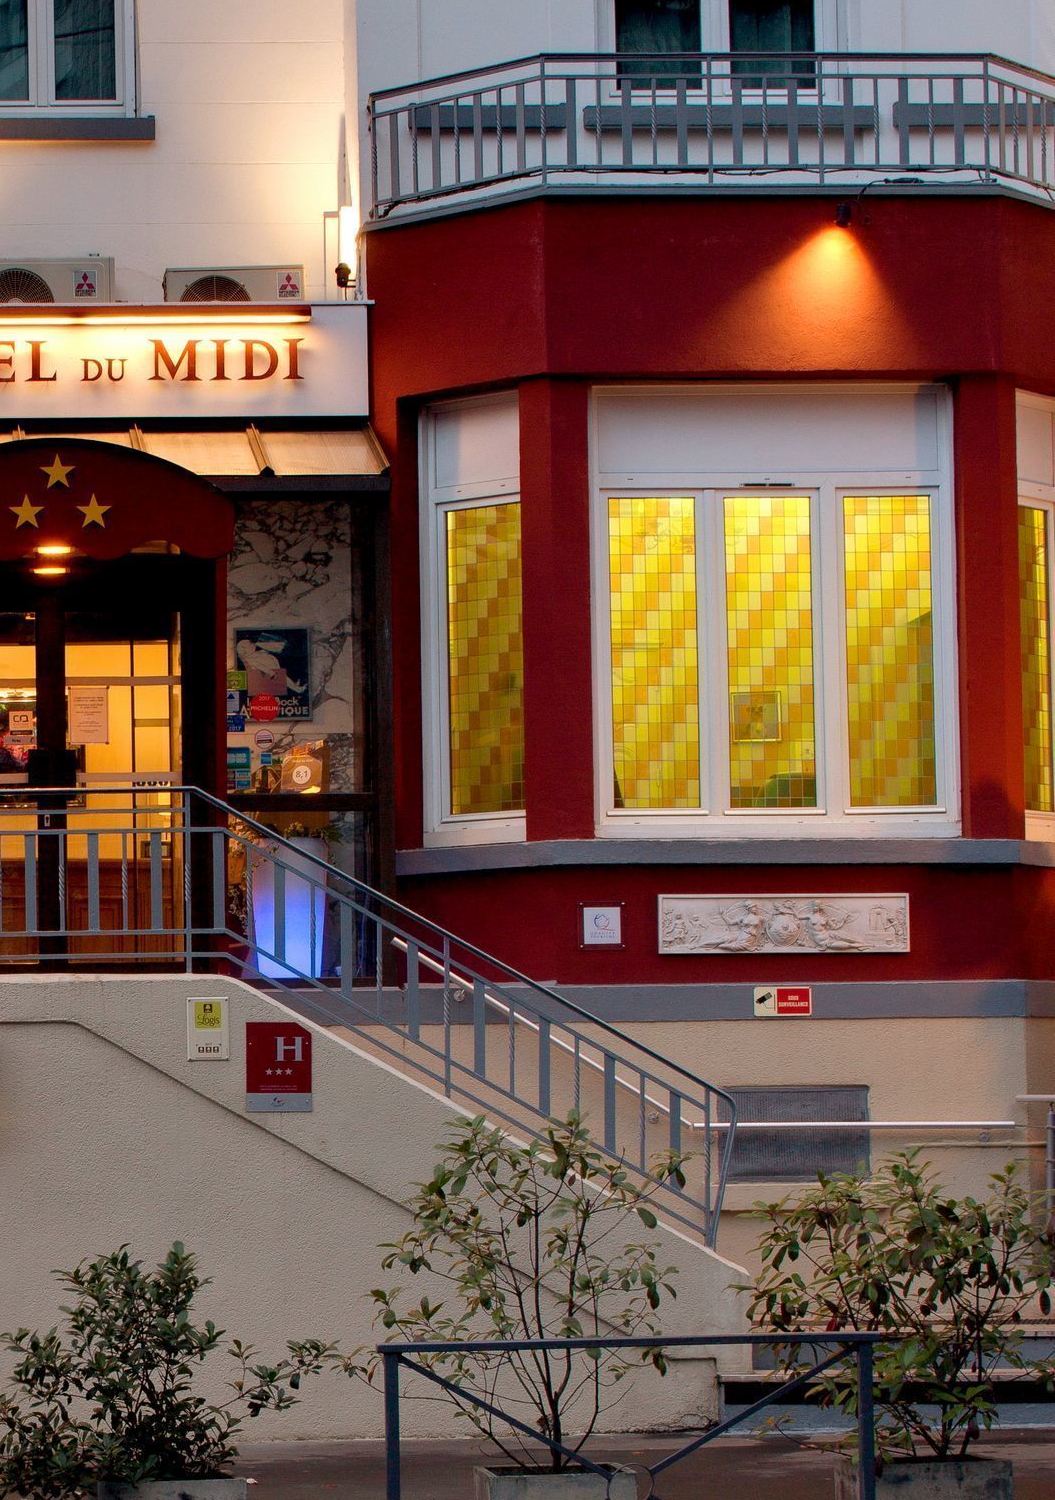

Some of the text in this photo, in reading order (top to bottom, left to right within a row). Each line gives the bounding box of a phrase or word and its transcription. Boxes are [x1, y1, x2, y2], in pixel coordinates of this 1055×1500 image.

[79, 358, 128, 382] DU
[147, 338, 305, 381] MIDI
[295, 770, 308, 778] 8,1
[196, 1014, 220, 1026] Logis
[274, 1037, 306, 1061] H
